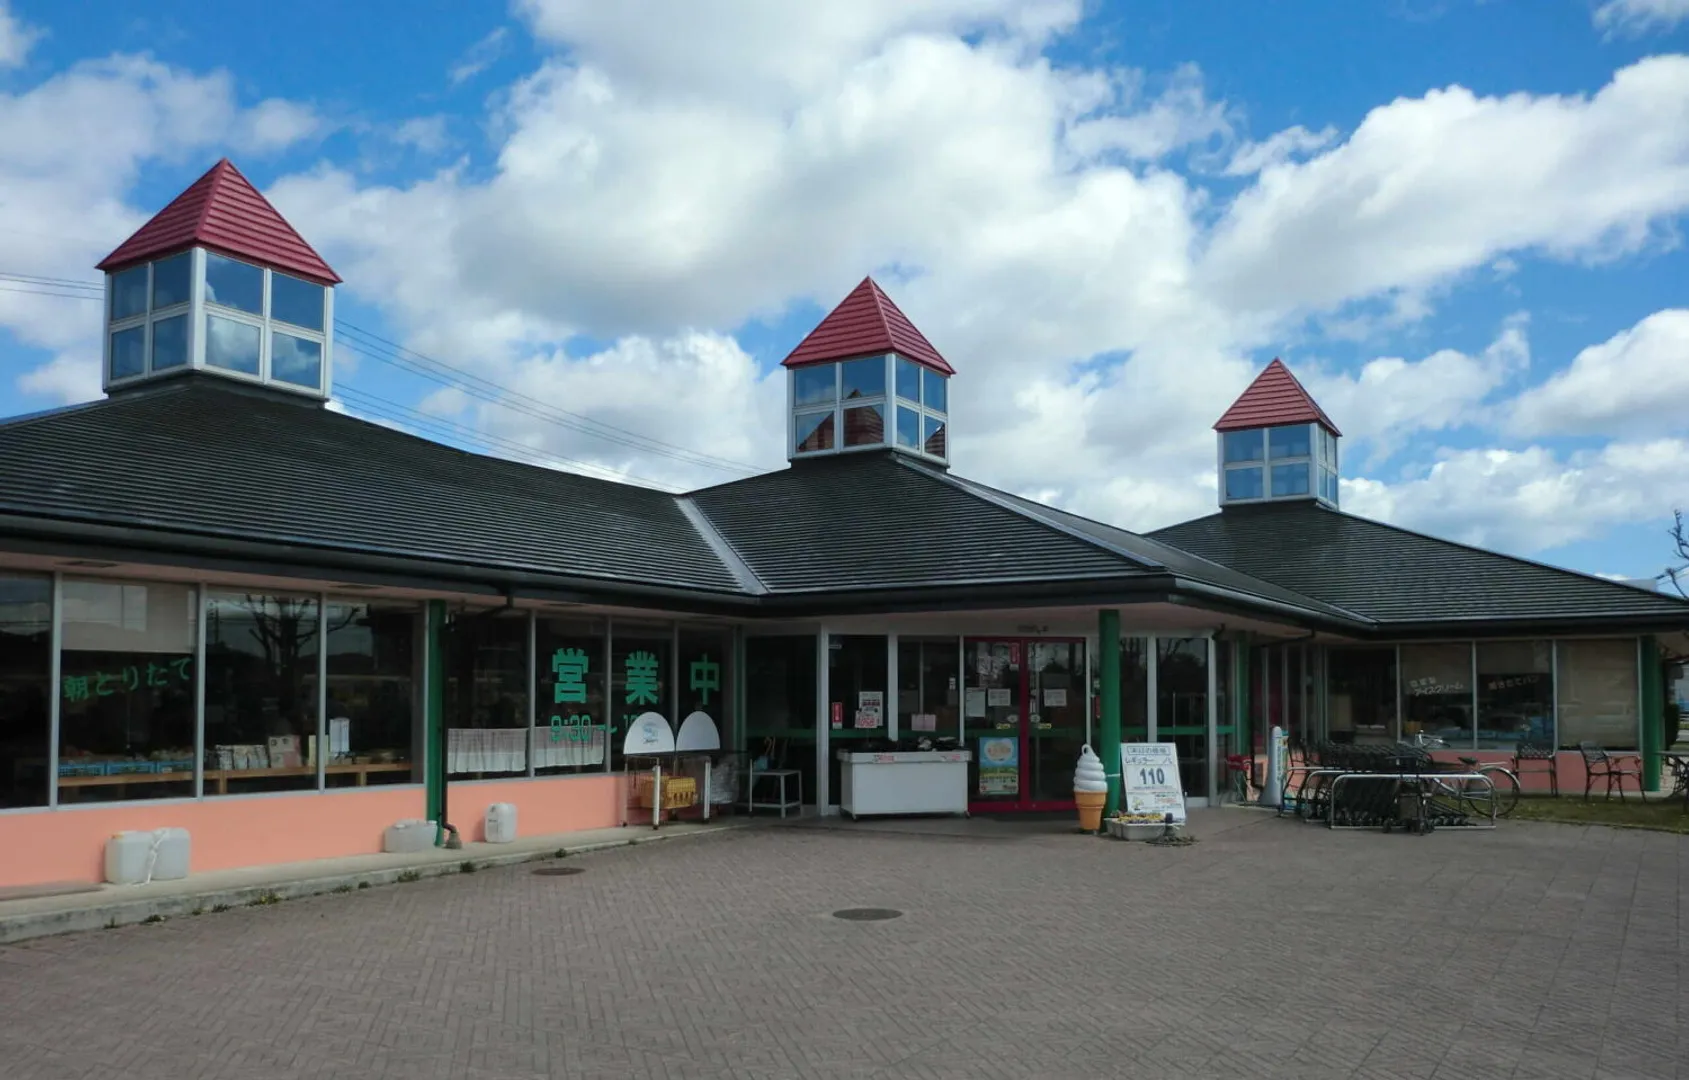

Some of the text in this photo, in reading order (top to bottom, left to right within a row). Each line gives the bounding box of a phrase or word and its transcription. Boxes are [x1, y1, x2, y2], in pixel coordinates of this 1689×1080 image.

[63, 657, 193, 702] 朝とりたて
[1140, 768, 1165, 785] 110
